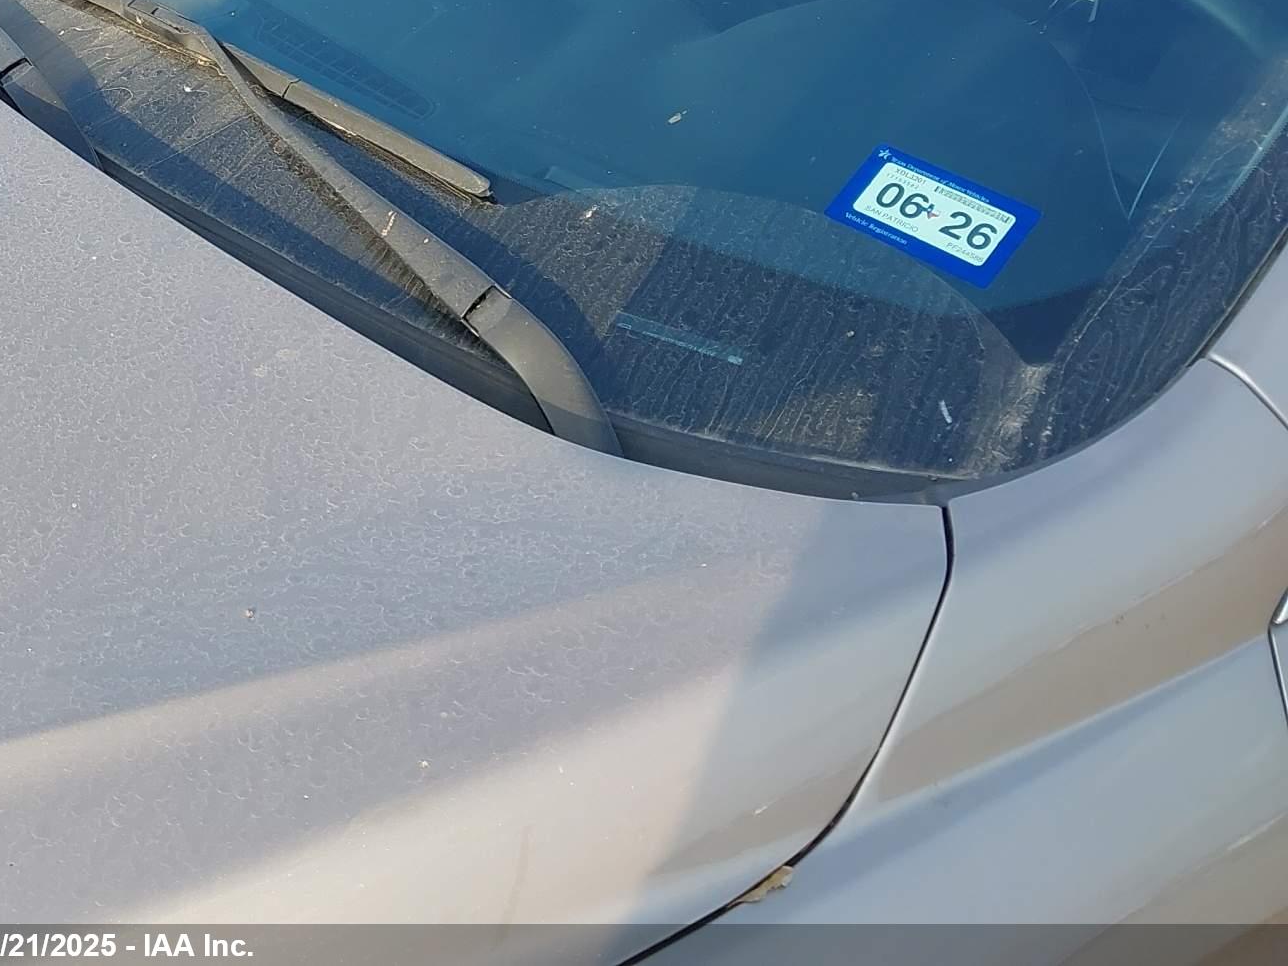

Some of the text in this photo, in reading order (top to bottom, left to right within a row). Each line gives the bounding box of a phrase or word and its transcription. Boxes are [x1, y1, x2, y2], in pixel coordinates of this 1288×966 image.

[845, 212, 908, 245] Vehicle Registration
[865, 205, 919, 233] SAN PATRICIO
[876, 182, 998, 250] 06 26
